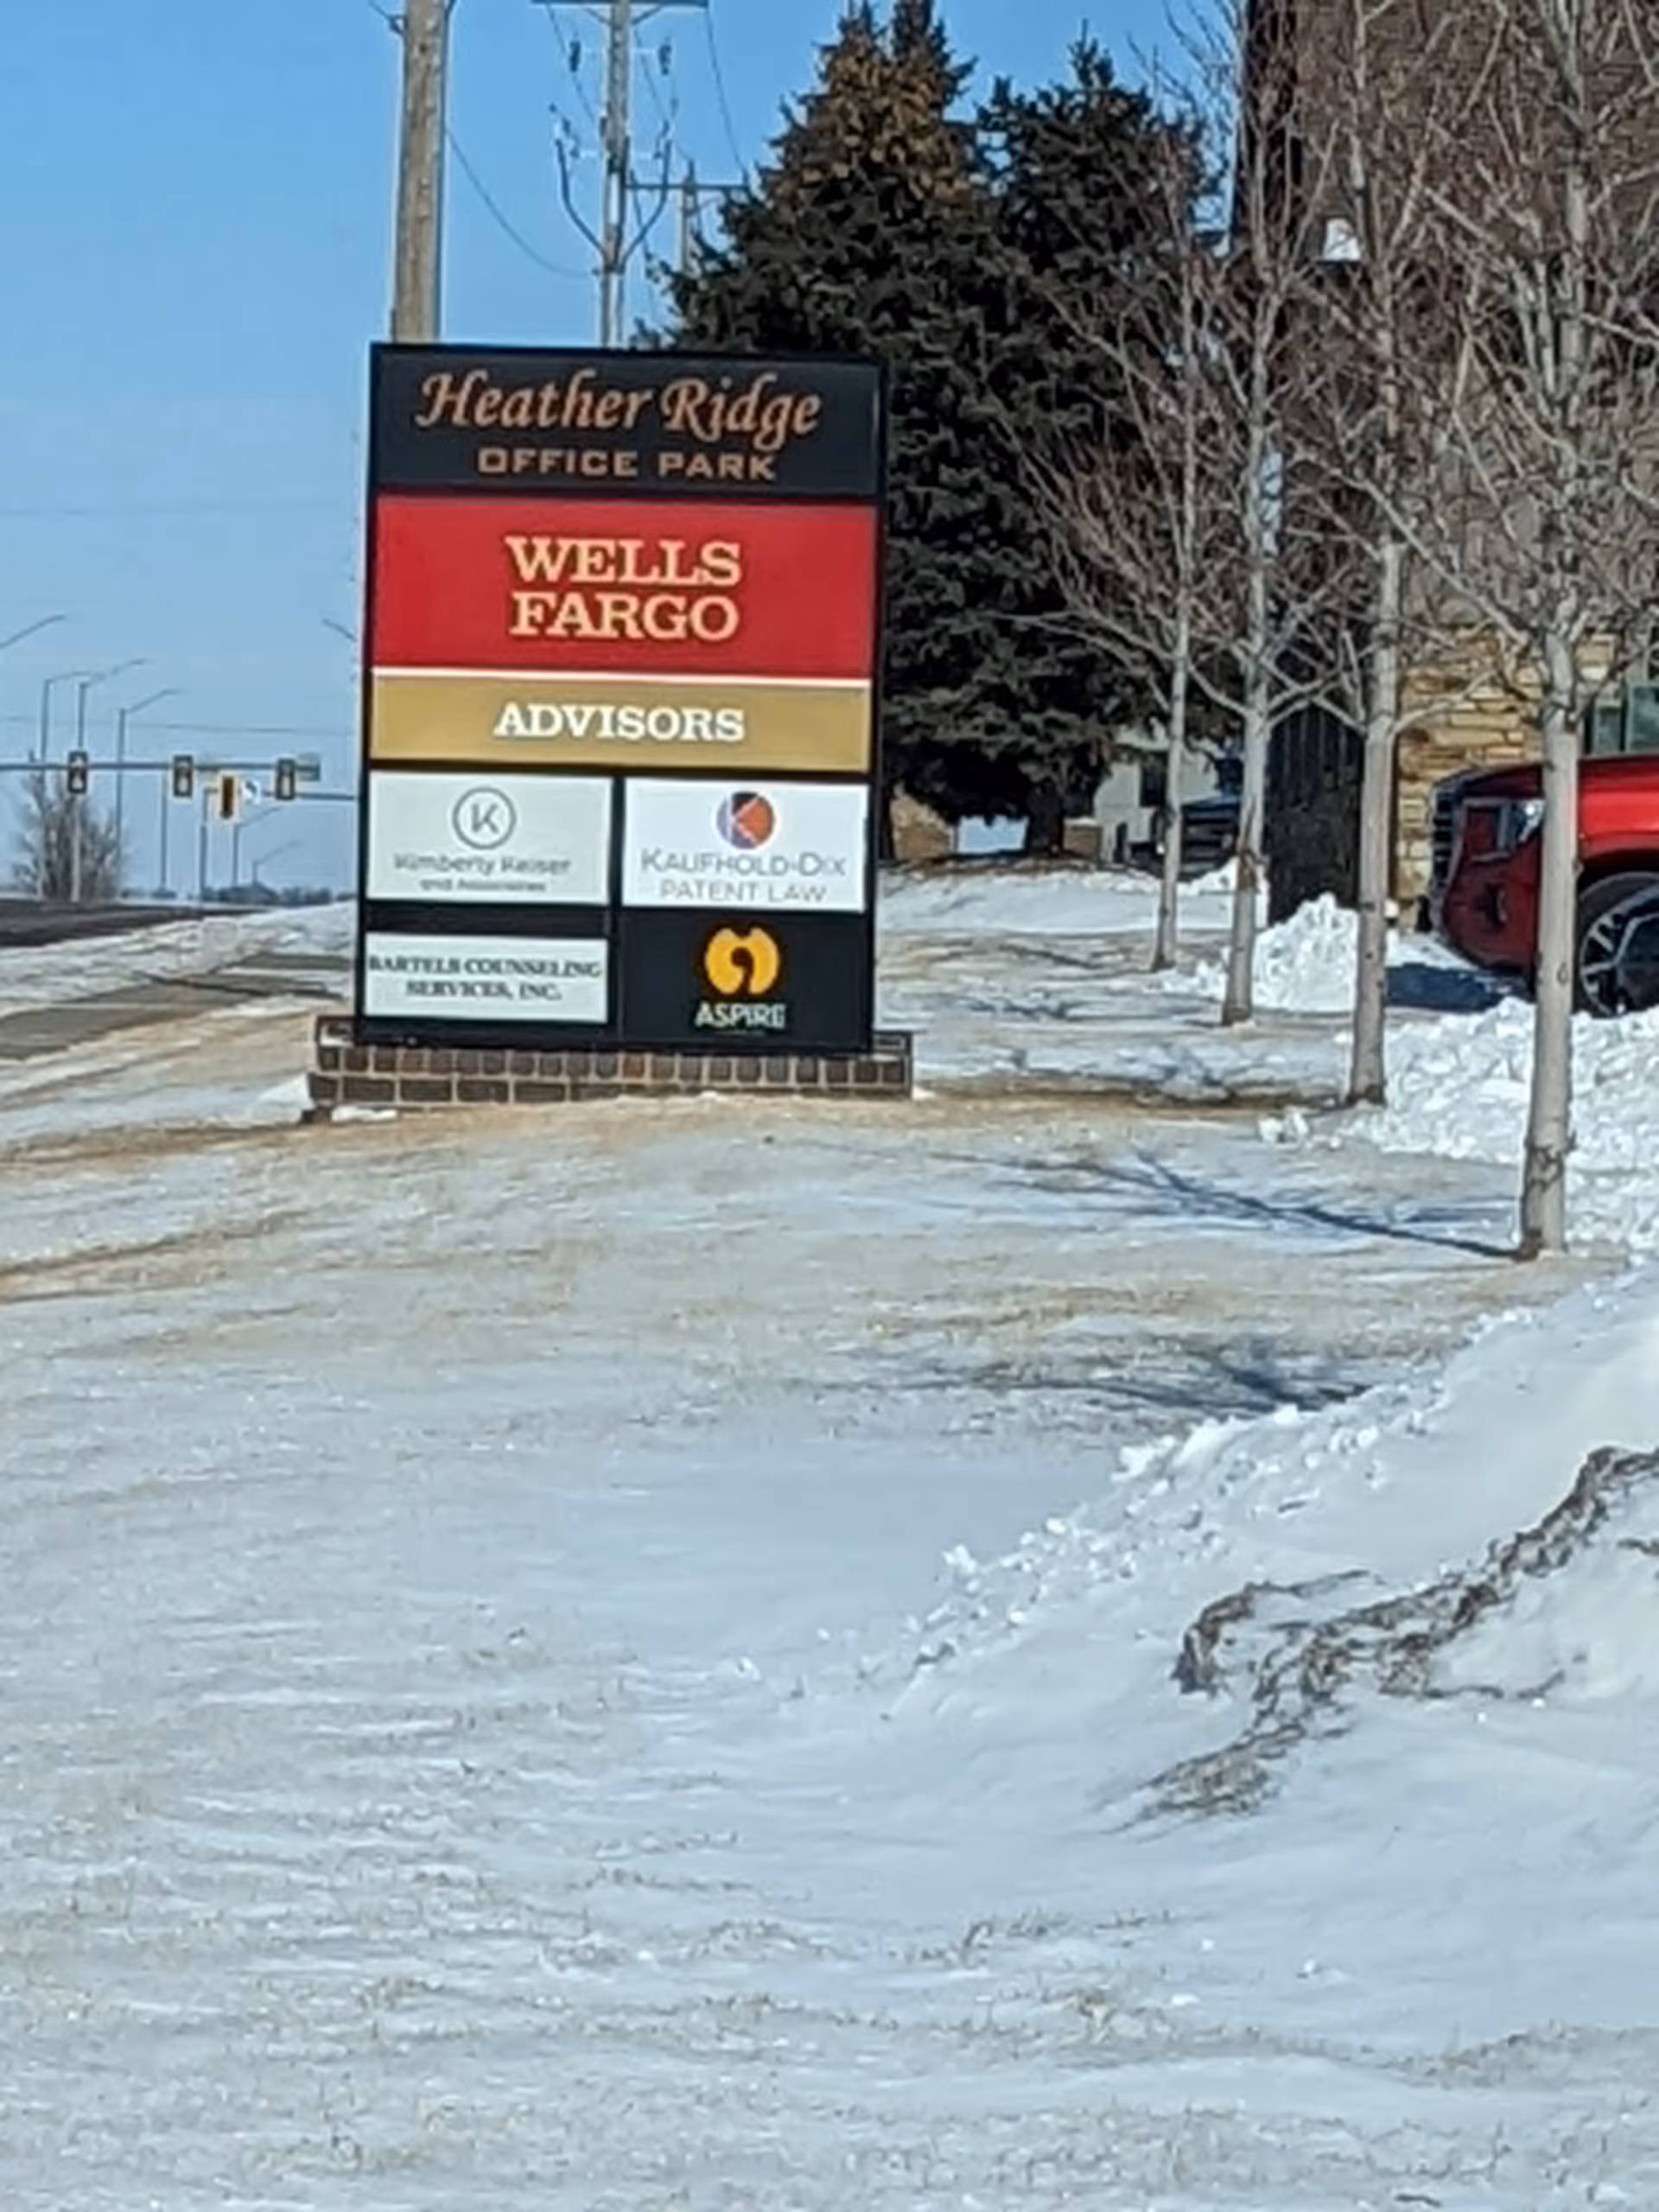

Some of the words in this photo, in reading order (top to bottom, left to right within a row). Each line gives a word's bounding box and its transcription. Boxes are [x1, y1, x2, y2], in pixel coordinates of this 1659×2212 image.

[415, 370, 652, 428] Heather
[660, 372, 822, 450] Ridge
[478, 447, 638, 477] OFFICE
[658, 452, 776, 480] PARK
[505, 536, 741, 587] WELLS
[509, 591, 740, 641] FARGO
[493, 702, 746, 742] ADVISORS
[660, 879, 758, 901] PATENT
[768, 884, 827, 903] LAW
[369, 955, 461, 974] BARTELS
[463, 957, 602, 977] COUNSELING
[695, 1001, 785, 1029] ASPIRE
